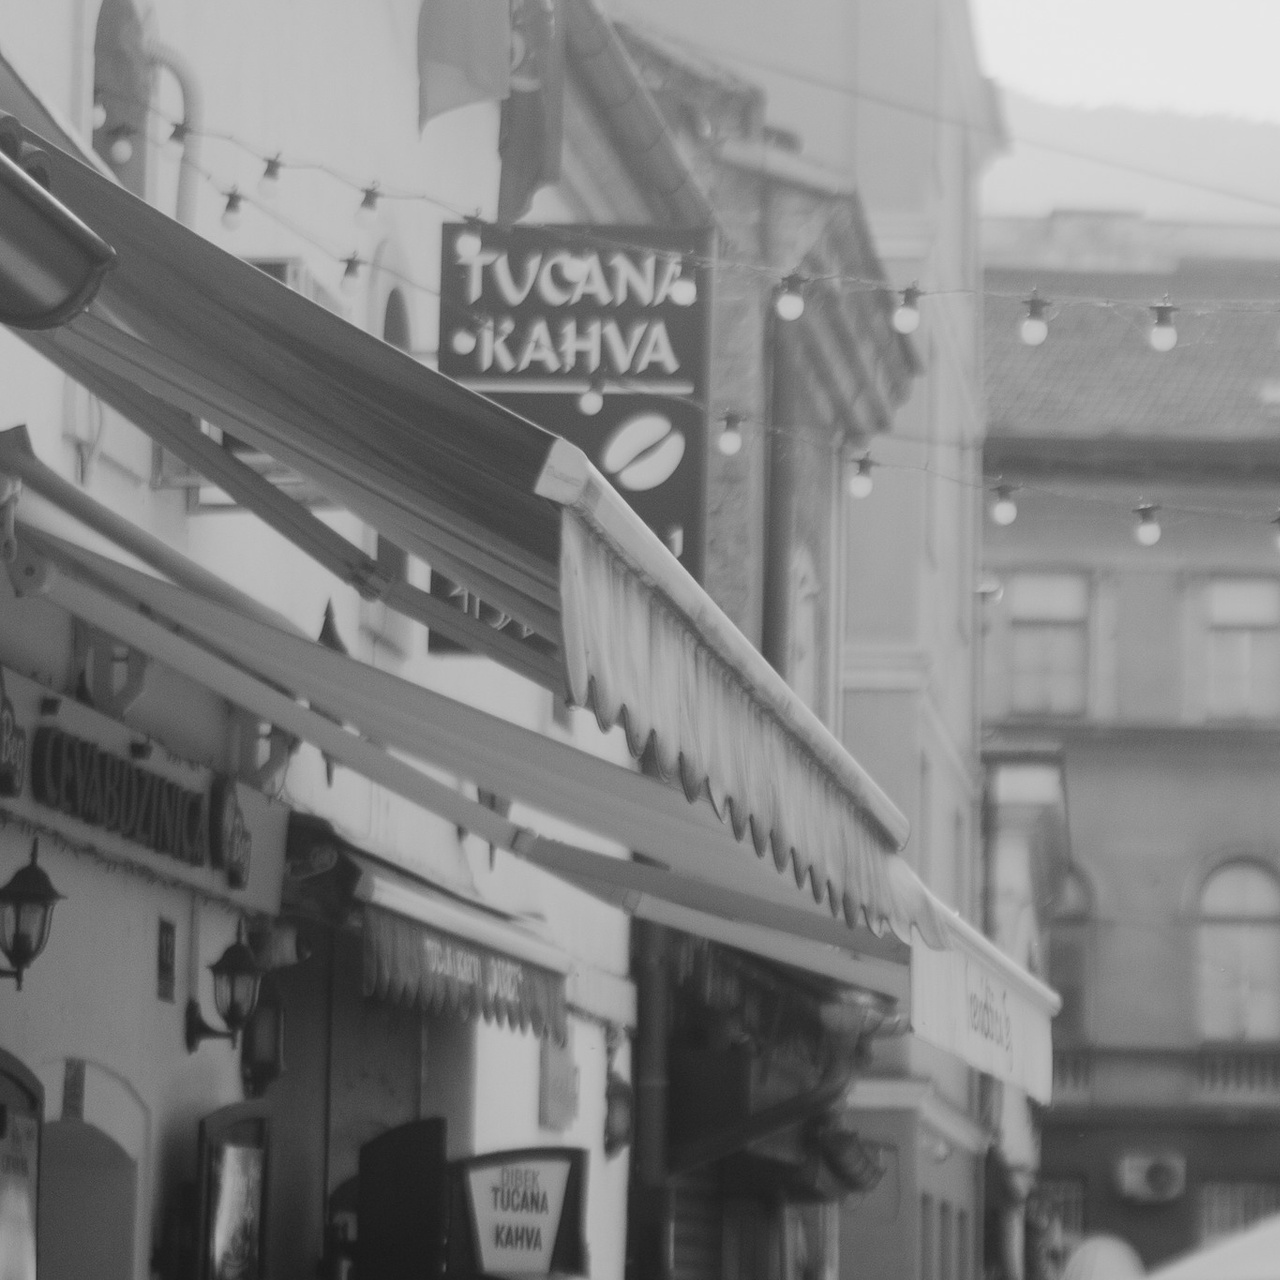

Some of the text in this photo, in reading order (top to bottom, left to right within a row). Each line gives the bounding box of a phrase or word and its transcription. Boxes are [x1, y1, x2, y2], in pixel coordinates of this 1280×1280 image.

[478, 316, 681, 375] KAHVA
[492, 1187, 549, 1214] TUCANA
[494, 1224, 542, 1251] KAHVA
